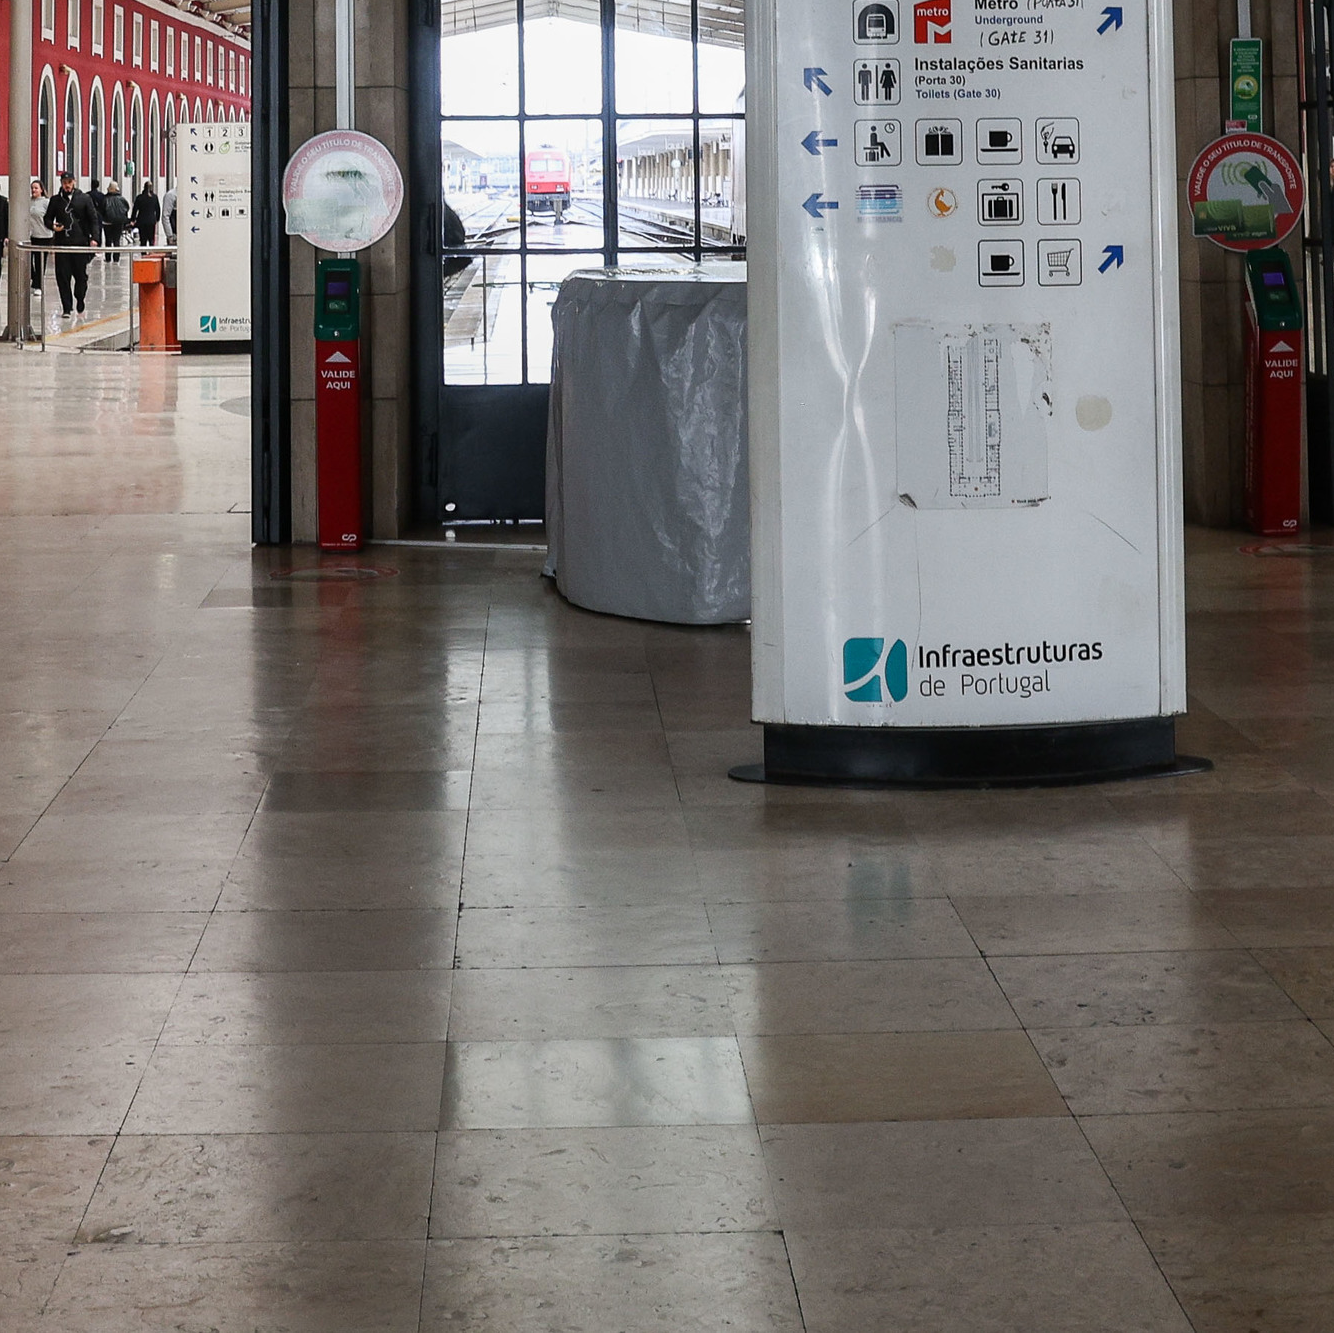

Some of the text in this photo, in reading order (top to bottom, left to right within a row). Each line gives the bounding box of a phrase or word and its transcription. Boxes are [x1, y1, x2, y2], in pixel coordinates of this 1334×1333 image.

[917, 8, 949, 16] metro
[975, 15, 1042, 26] Underground
[915, 57, 1083, 73] Instalações Sanitarias
[915, 76, 965, 87] (Porta 30)
[916, 89, 1000, 100] Toilets (Gate 30)
[208, 129, 244, 137] 1 2 3
[1195, 167, 1206, 195] VALIDE
[1208, 148, 1222, 161] SEU
[1223, 140, 1249, 151] TÍTULO
[1251, 141, 1262, 149] DE
[1263, 145, 1297, 189] TRANSPORTE
[1265, 359, 1297, 367] VALIDE
[320, 370, 355, 378] VALIDE
[325, 381, 350, 390] AQUI
[919, 641, 1102, 668] Infraestruturas
[920, 670, 1050, 698] de Portugal
